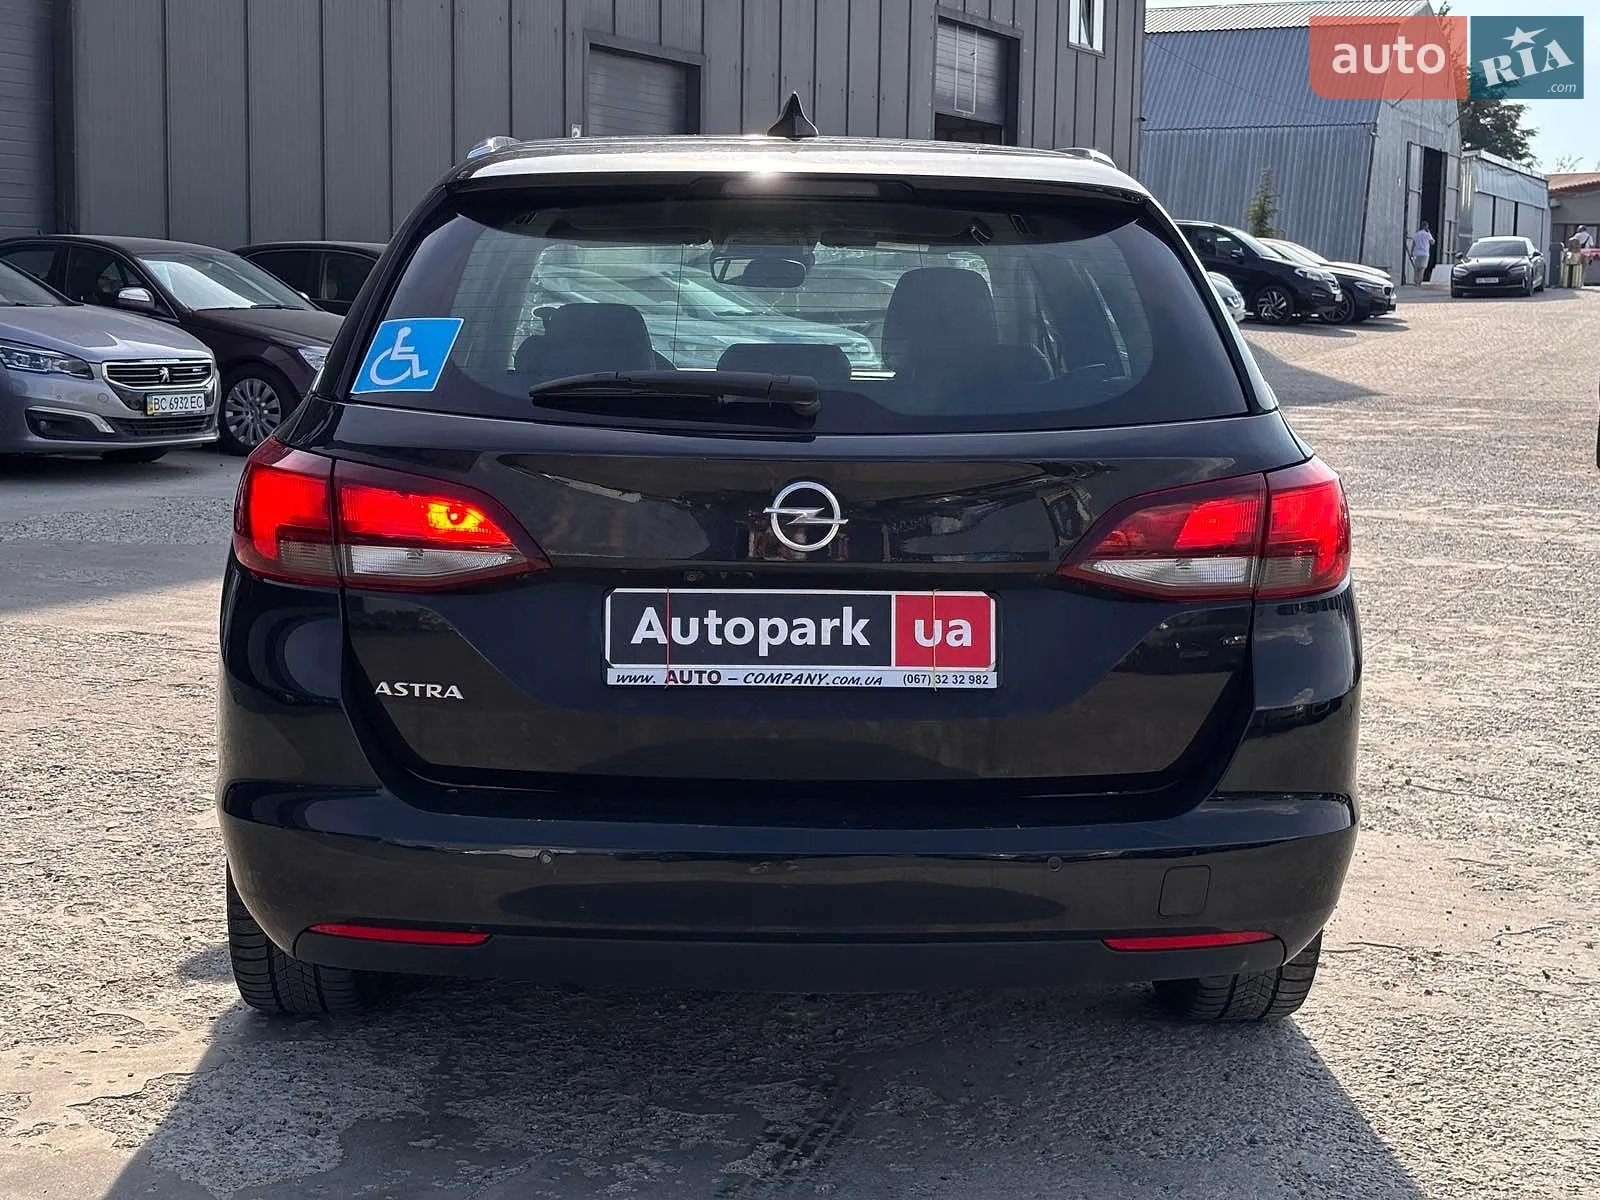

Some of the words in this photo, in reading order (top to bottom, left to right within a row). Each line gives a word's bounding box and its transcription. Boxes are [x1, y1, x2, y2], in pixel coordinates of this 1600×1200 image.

[153, 397, 167, 411] BC
[169, 396, 189, 410] 6932
[190, 395, 203, 409] EC
[630, 606, 871, 656] Autopark
[914, 617, 973, 647] ua
[664, 670, 722, 685] AUTO
[903, 673, 931, 686] (067)
[934, 674, 949, 685] 32
[951, 674, 966, 685] 32
[968, 674, 989, 685] 982
[374, 681, 465, 700] ASTRA
